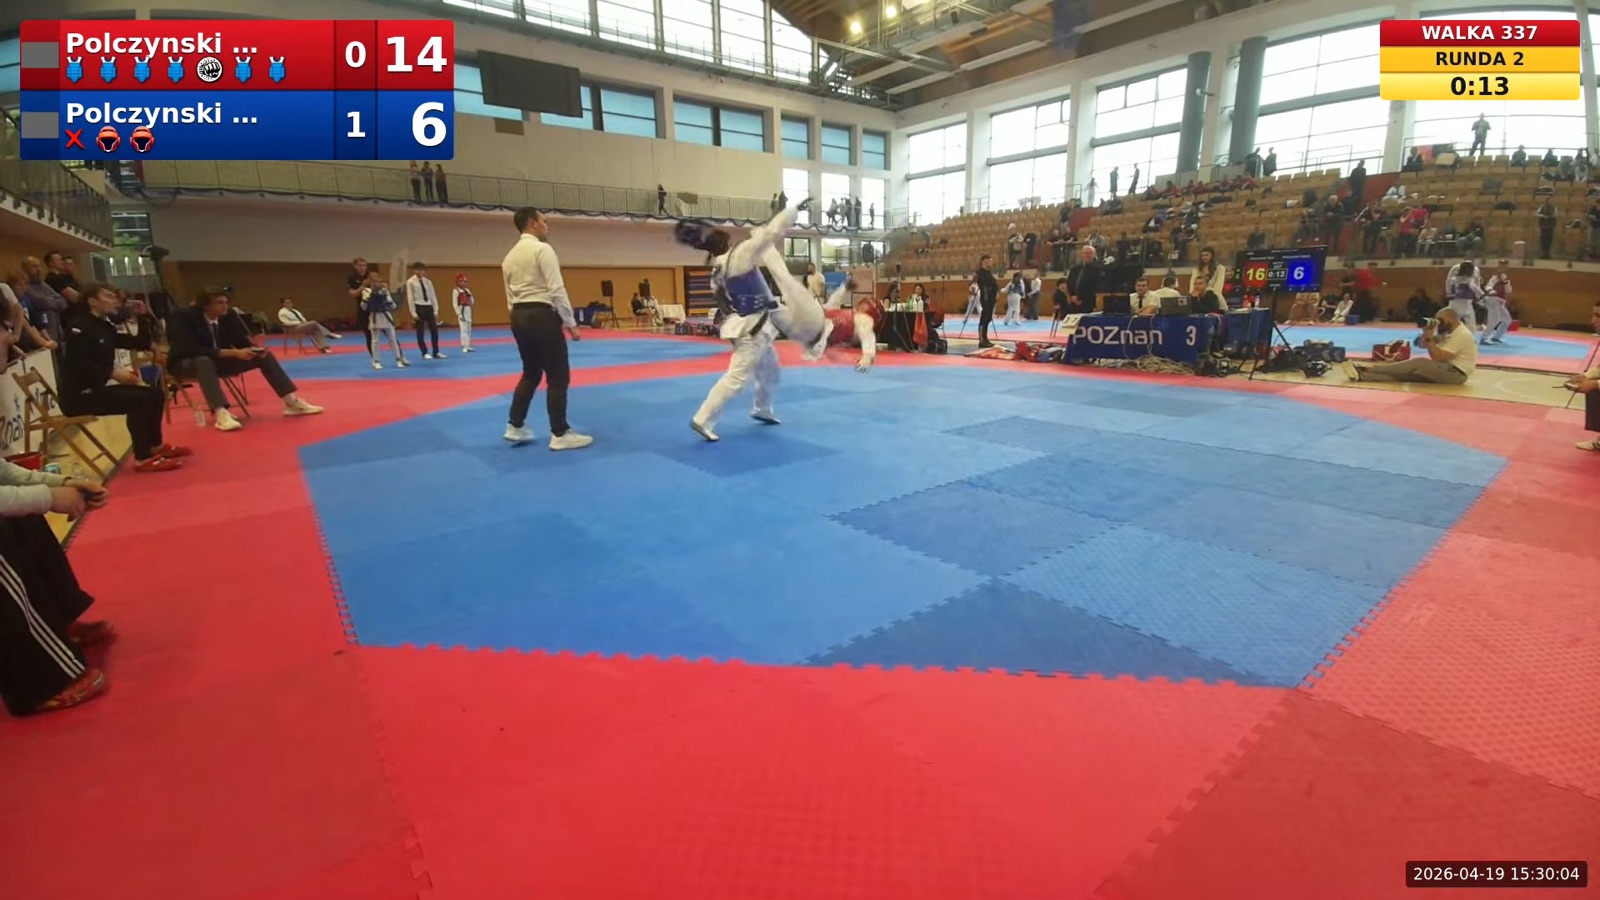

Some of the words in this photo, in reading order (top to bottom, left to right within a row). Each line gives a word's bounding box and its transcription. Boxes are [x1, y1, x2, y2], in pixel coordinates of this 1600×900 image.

[1247, 268, 1265, 280] 16
[1294, 267, 1304, 280] 6
[1186, 325, 1197, 346] 3
